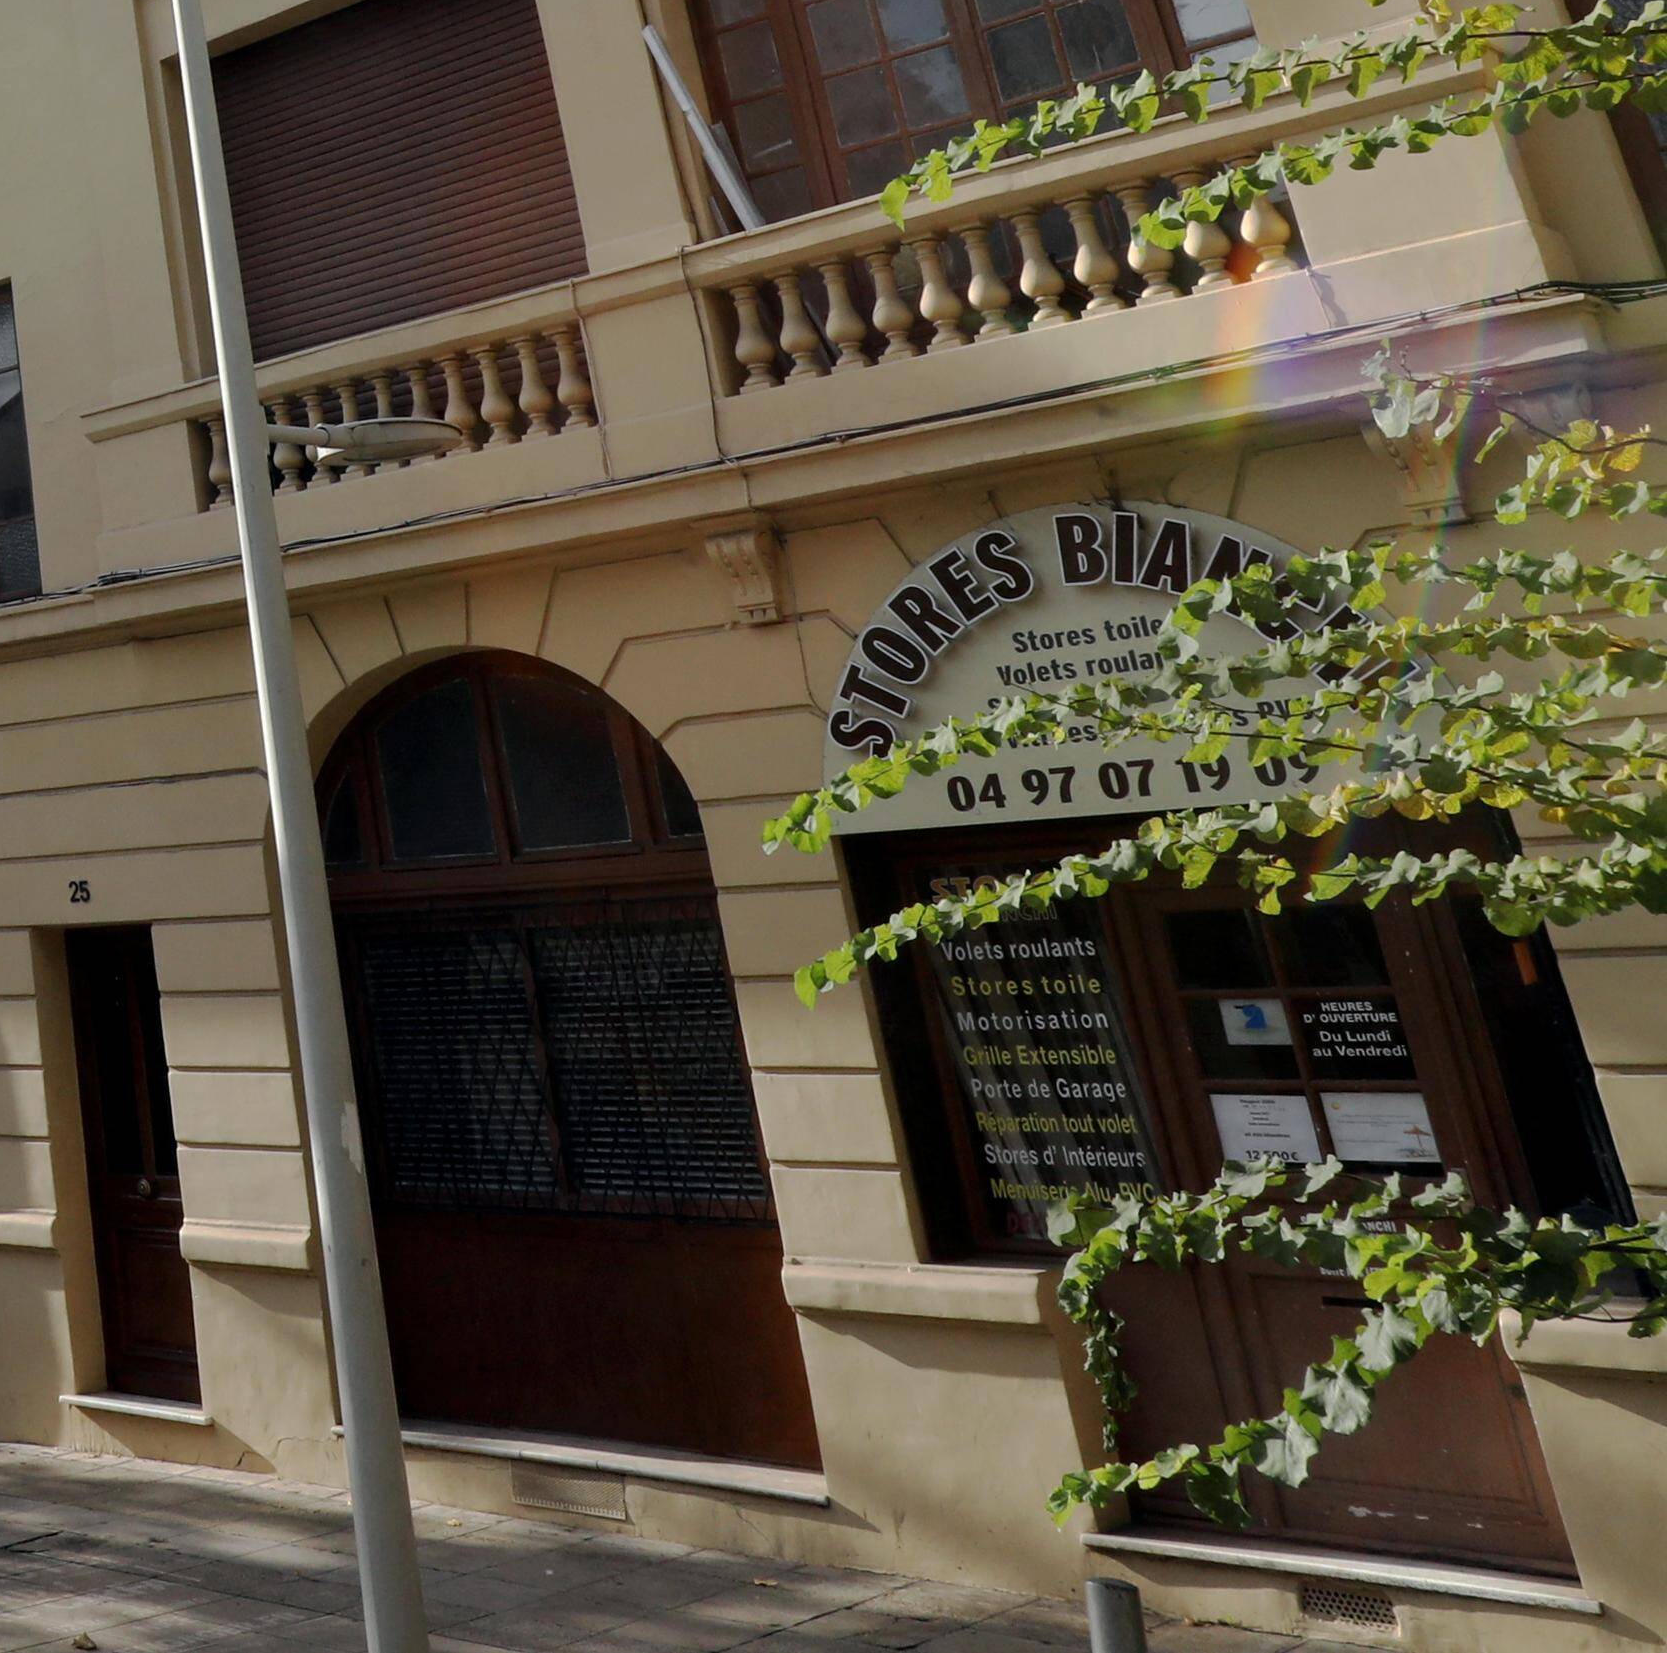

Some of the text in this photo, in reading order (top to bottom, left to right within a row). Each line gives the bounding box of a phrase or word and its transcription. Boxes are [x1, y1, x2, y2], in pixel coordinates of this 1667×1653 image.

[829, 530, 1034, 760] STORES
[1012, 626, 1096, 653] Stores
[996, 658, 1077, 686] Volets
[947, 773, 1007, 812] 04
[1021, 766, 1077, 806] 97
[1097, 759, 1155, 800] 07
[1175, 755, 1231, 793] 19
[68, 880, 91, 903] 25
[942, 937, 1097, 961] Volets roulants
[951, 974, 1102, 996] Stores toile
[1320, 1012, 1398, 1023] OUVERTURE
[1321, 1001, 1373, 1012] HEURES
[956, 1009, 1110, 1031] Motorisation
[1319, 1029, 1392, 1042] Du Lundi
[963, 1044, 1116, 1065] Grille Extensible
[1313, 1045, 1408, 1057] au Vendredi
[970, 1077, 1126, 1103] Porte de Garage
[975, 1111, 1139, 1136] Réparation tout volet
[984, 1144, 1039, 1165] Stores
[1062, 1145, 1147, 1168] Intérieurs
